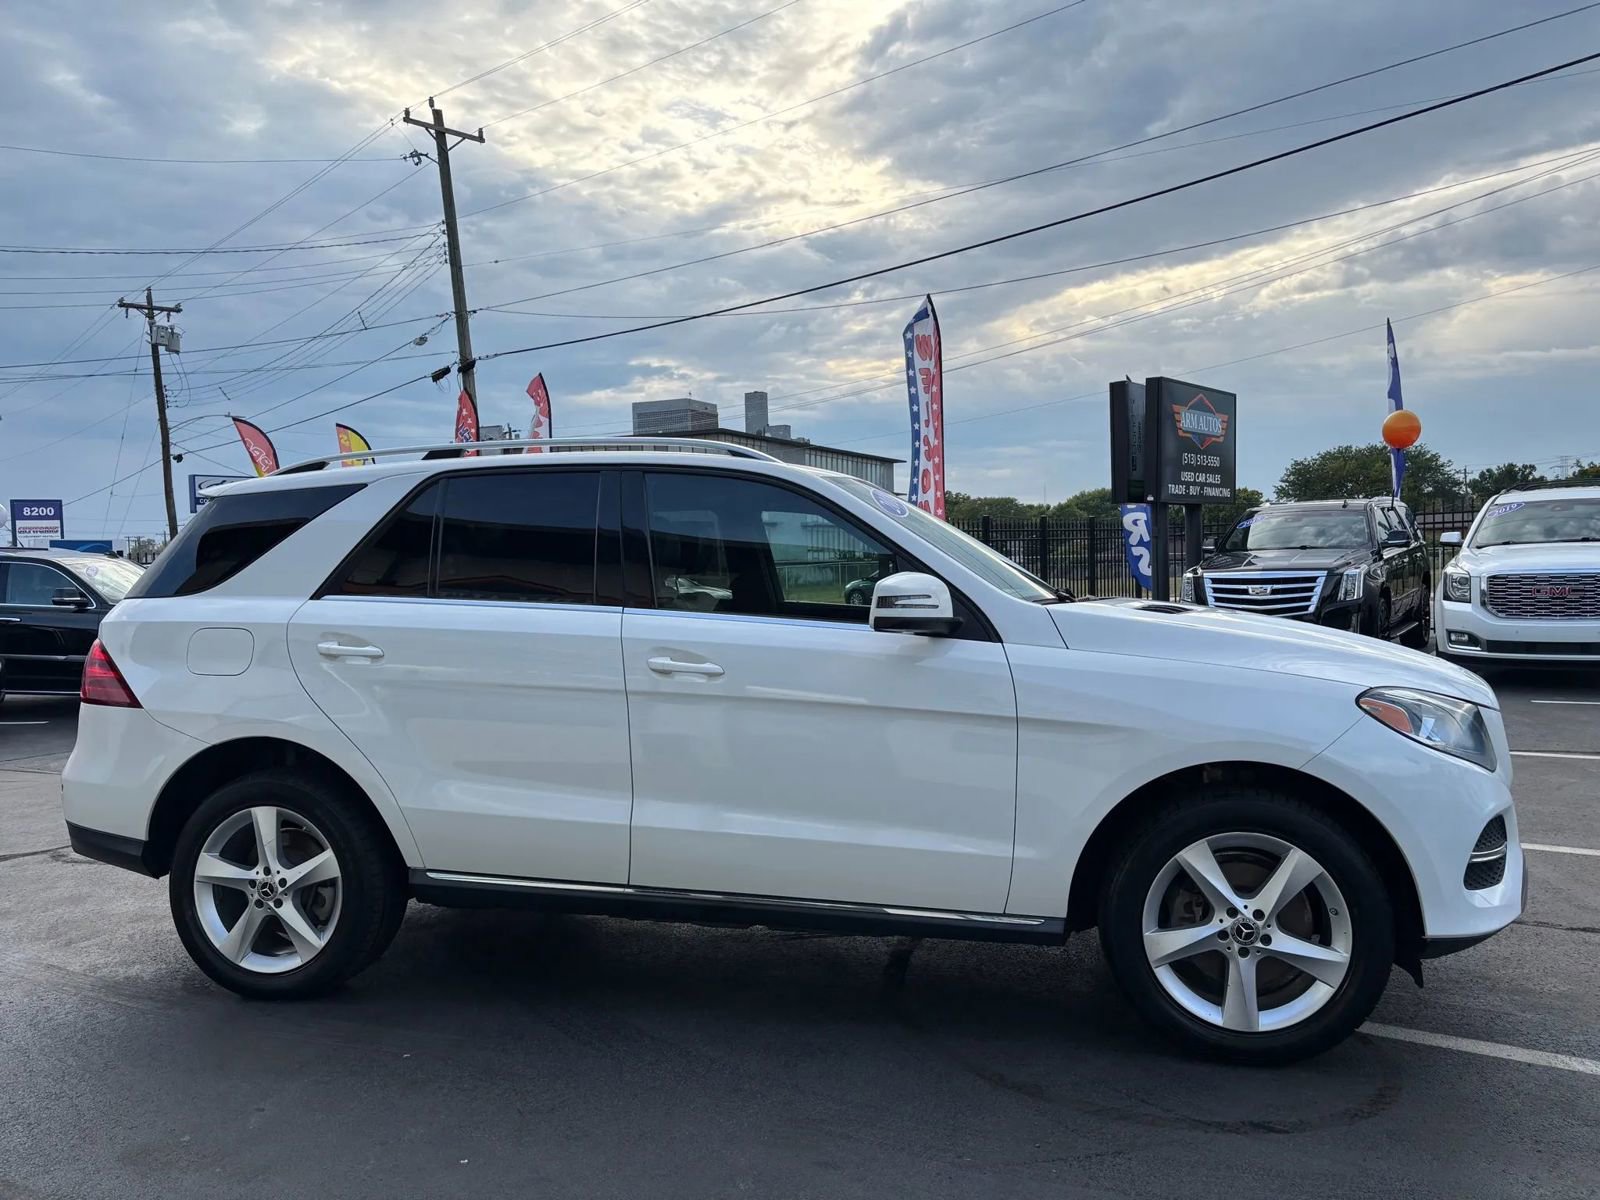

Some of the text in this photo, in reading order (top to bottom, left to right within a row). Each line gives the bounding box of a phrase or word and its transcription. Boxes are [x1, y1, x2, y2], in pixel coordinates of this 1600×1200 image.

[1180, 411, 1222, 433] ARM AUTOS
[1182, 453, 1220, 467] (513) 513-5550
[1180, 471, 1221, 484] USED CAR SALES
[1168, 484, 1231, 498] TRADE BUY FINANCING
[22, 506, 55, 516] 8200
[1531, 585, 1585, 597] GMC
